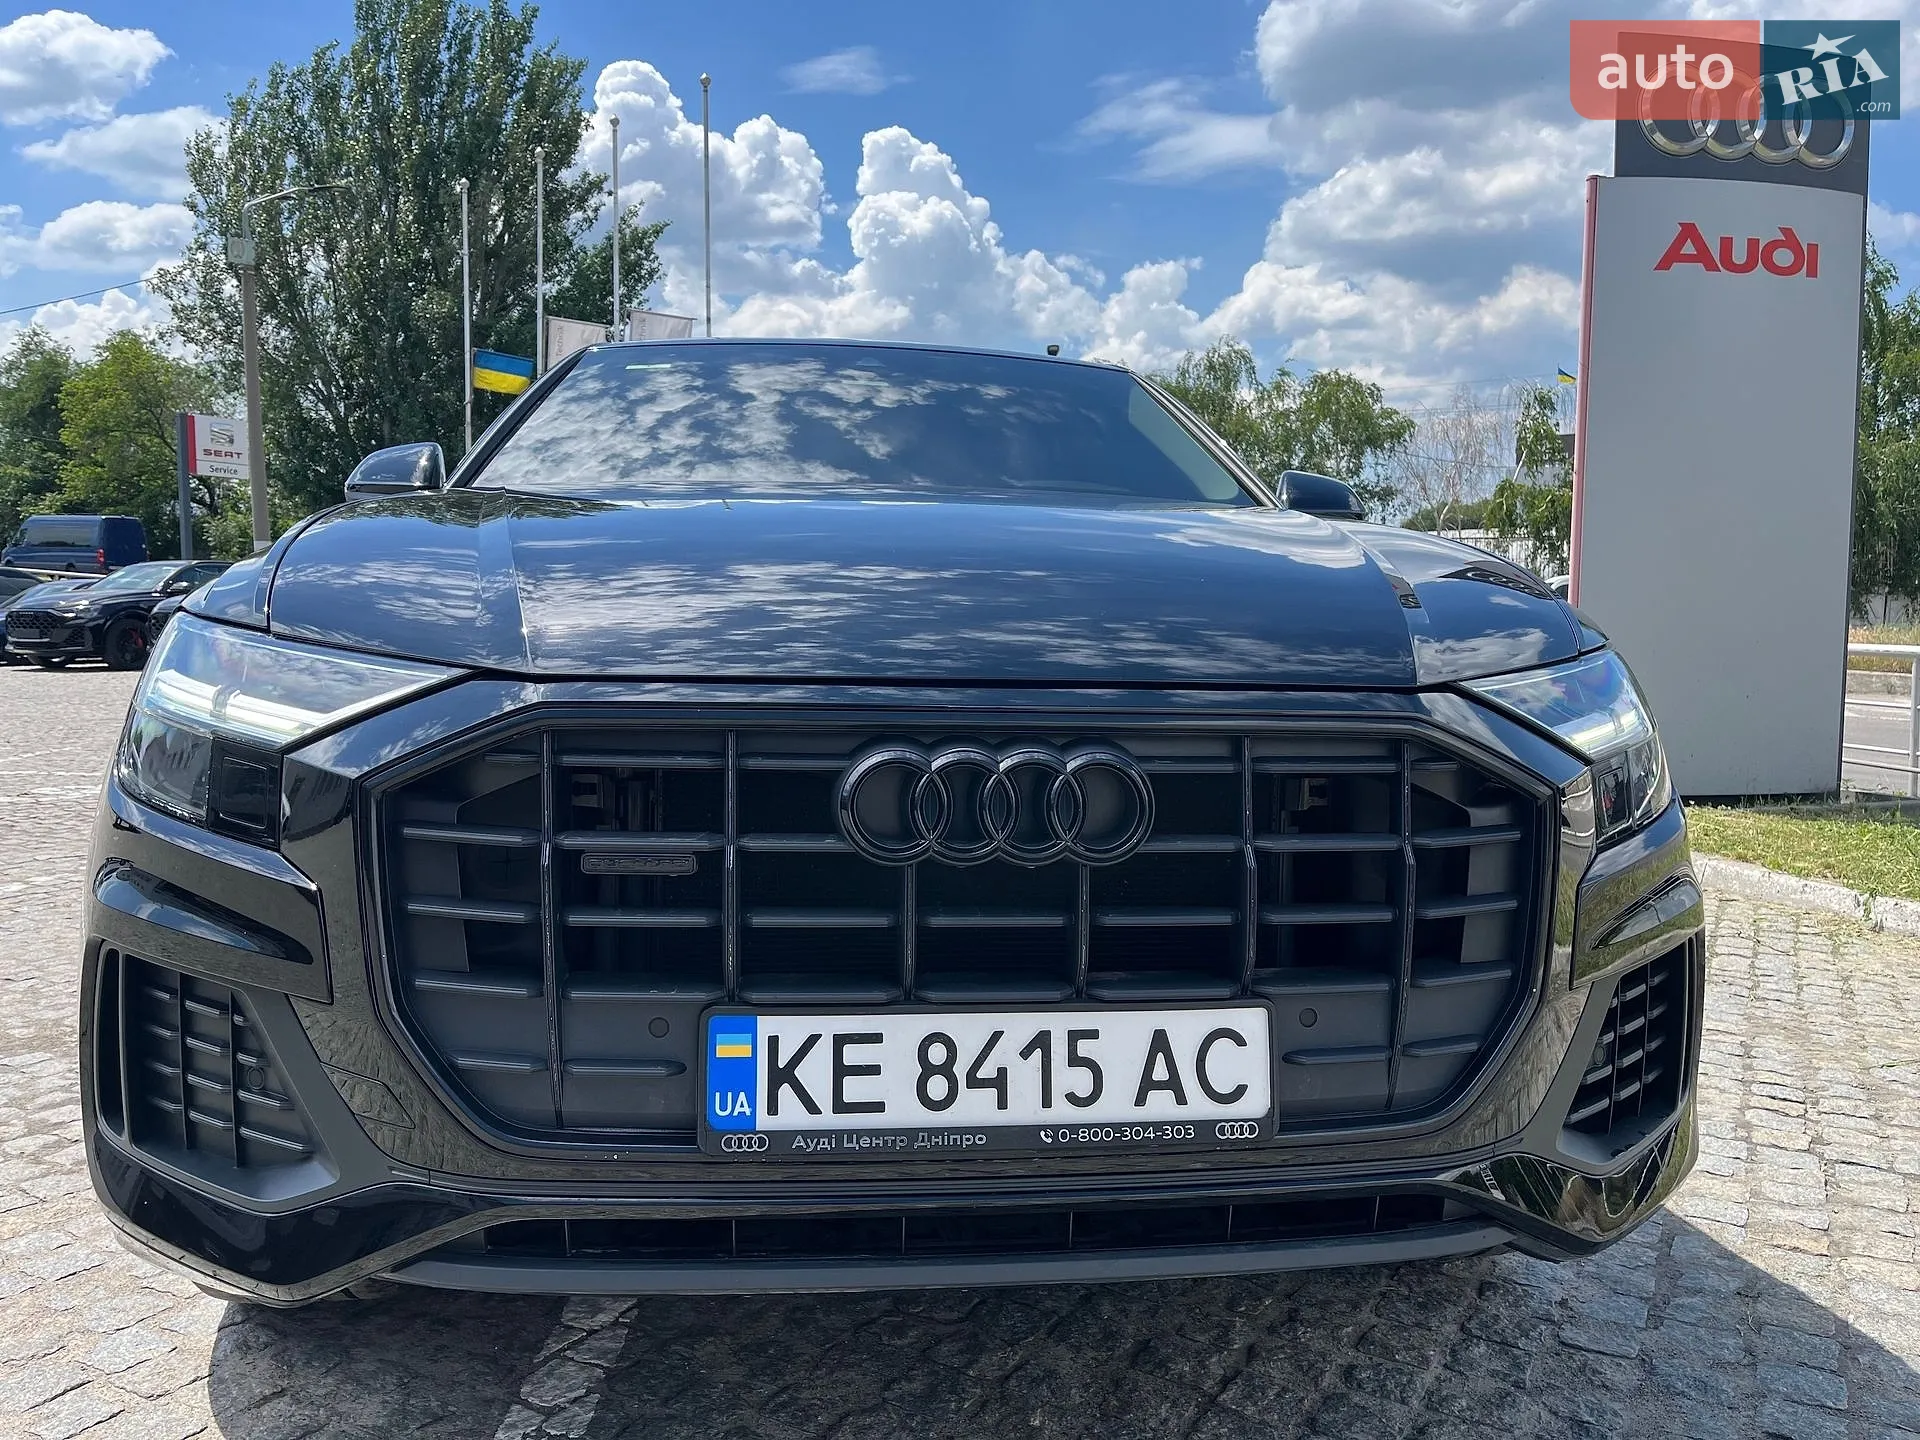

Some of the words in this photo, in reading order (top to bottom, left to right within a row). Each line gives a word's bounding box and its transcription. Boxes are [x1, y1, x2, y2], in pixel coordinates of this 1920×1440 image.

[1653, 222, 1820, 279] Audi
[203, 448, 243, 459] SEAT
[209, 465, 238, 475] Service
[766, 1033, 886, 1116] KE
[916, 1029, 1104, 1112] 8415
[1133, 1026, 1250, 1108] AC
[714, 1091, 751, 1116] UA
[791, 1134, 838, 1152] Ауді
[843, 1133, 909, 1151] Центр
[913, 1131, 987, 1149] Дніпро
[1057, 1125, 1195, 1143] 0-800-304-303
